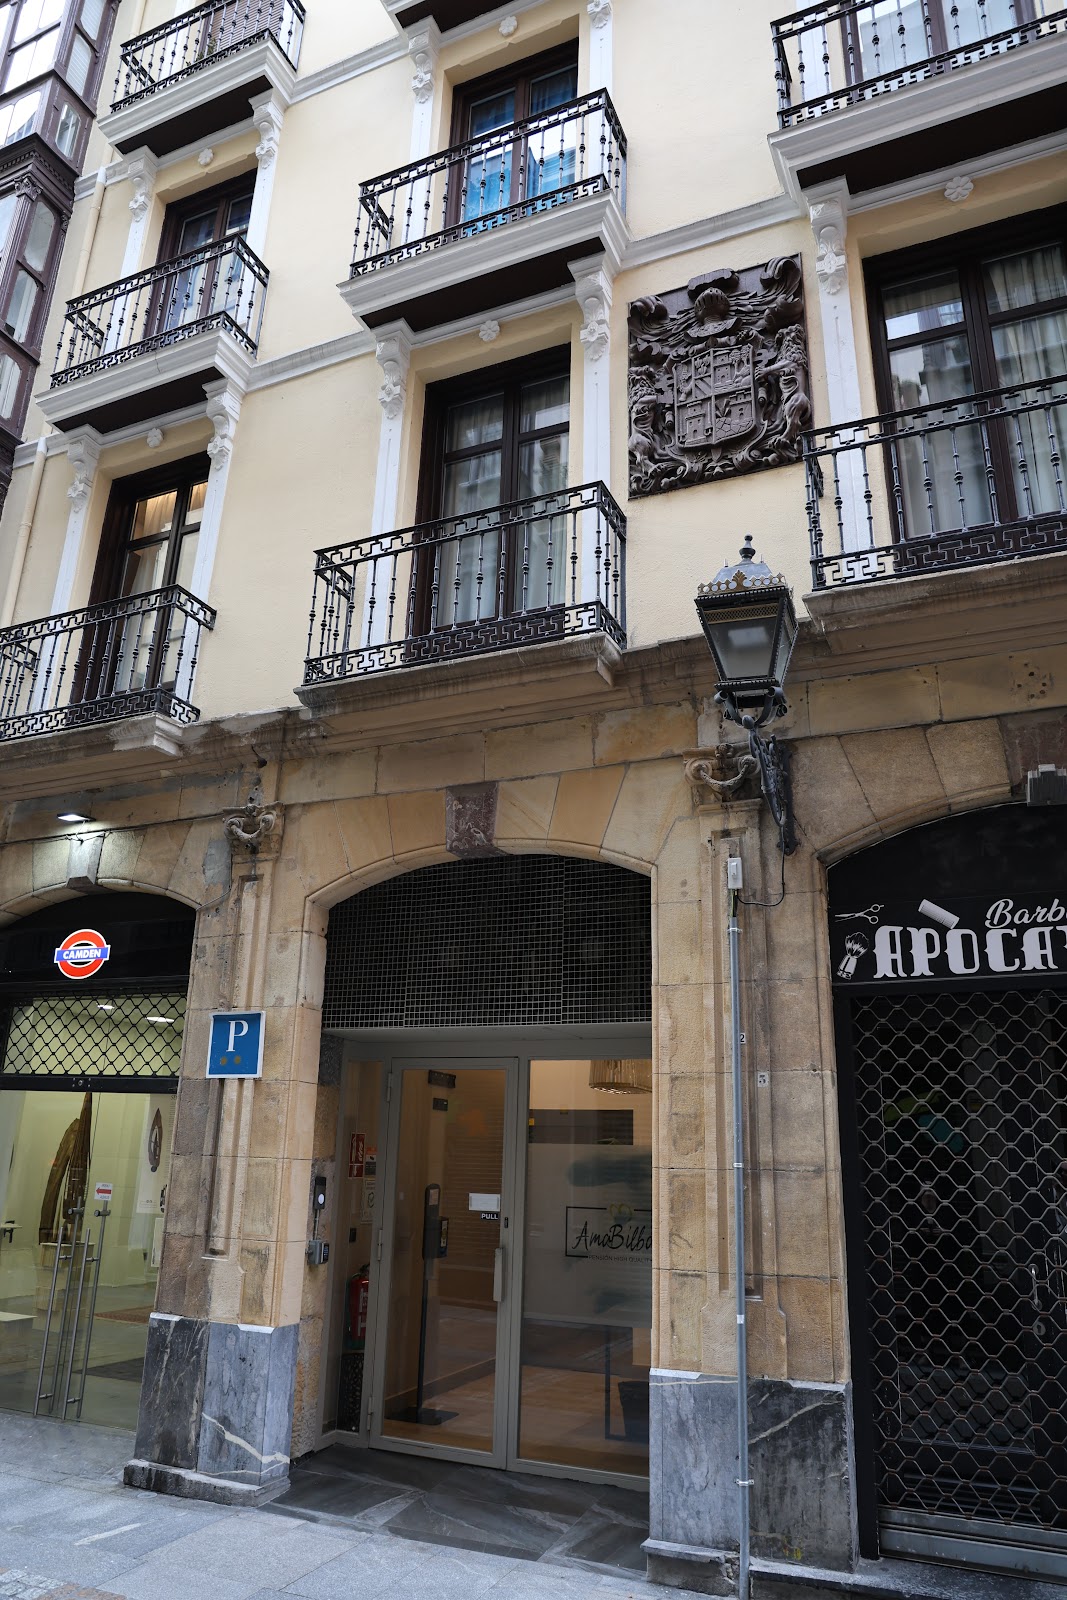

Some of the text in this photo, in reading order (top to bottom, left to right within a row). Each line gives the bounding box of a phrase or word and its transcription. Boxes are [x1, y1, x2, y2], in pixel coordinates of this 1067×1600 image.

[984, 898, 1067, 929] Barb
[62, 948, 102, 960] CAMDEN
[873, 925, 1067, 979] APOCA
[225, 1020, 249, 1052] P
